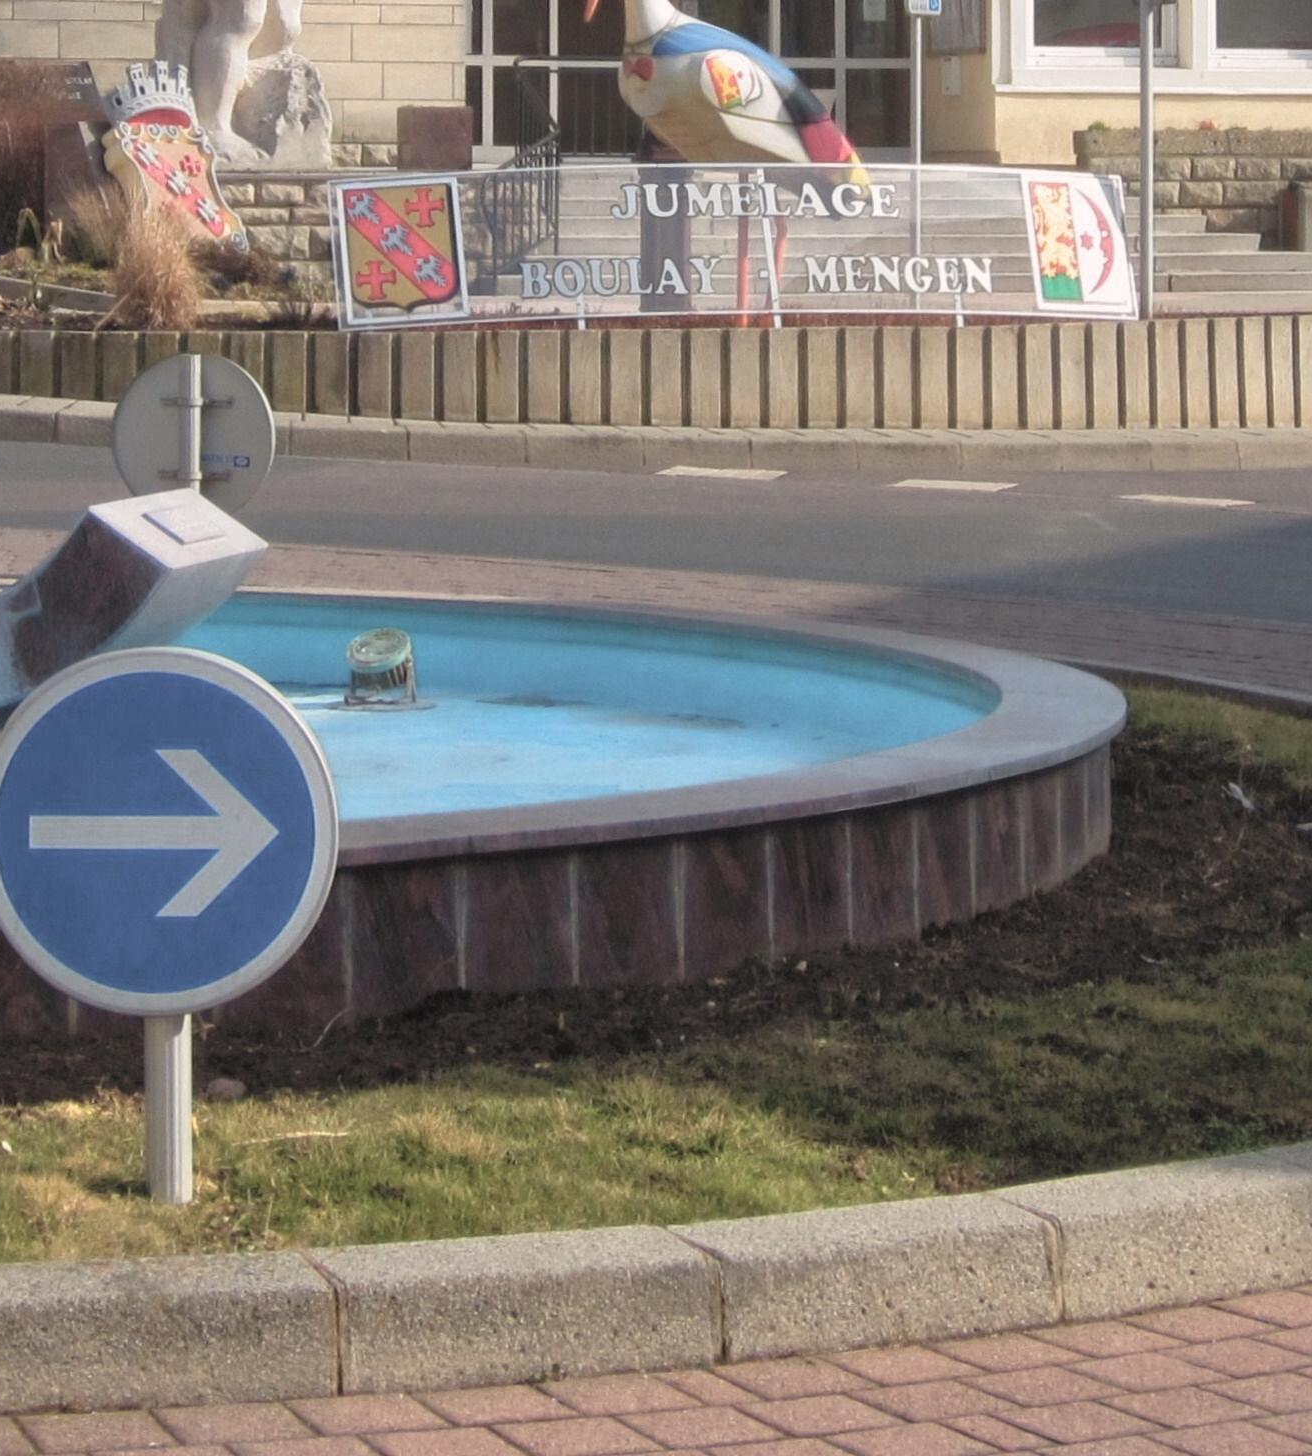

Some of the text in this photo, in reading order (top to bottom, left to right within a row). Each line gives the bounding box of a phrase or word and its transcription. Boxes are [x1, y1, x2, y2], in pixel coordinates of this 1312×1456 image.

[610, 181, 900, 220] JUMELAGE
[519, 255, 722, 299] BOULAY
[804, 254, 994, 294] MENGEN
